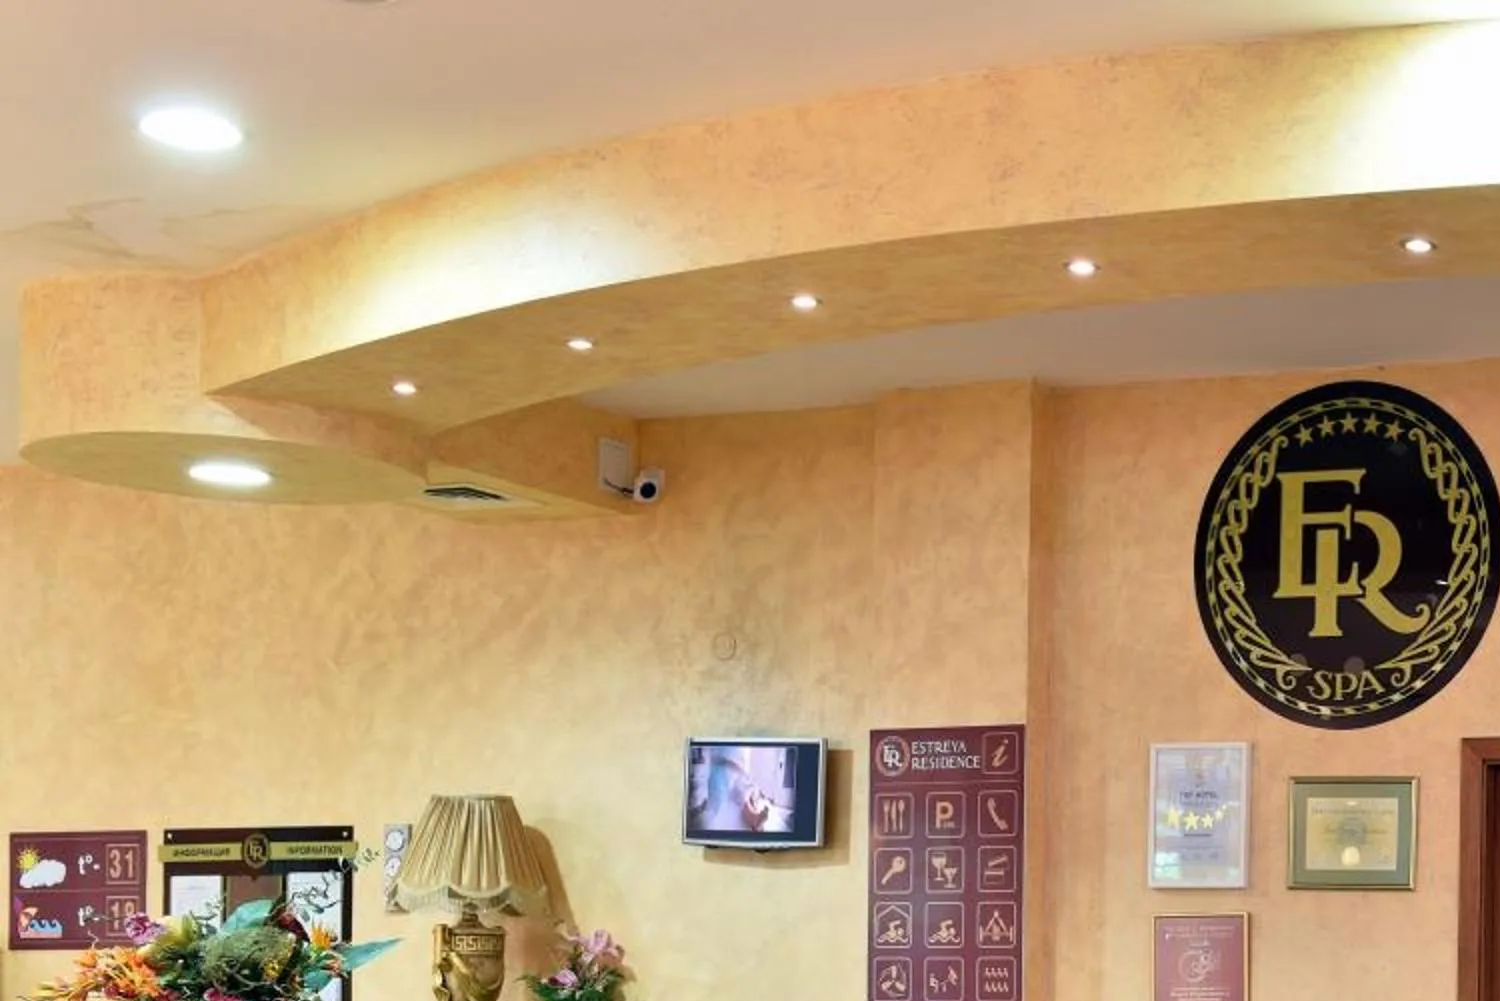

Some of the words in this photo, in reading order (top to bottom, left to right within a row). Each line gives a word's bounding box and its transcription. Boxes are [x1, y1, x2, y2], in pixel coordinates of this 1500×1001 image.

[1306, 669, 1386, 701] SPA
[911, 739, 968, 755] ESTREYA
[911, 755, 981, 770] RESIDENCE
[935, 800, 954, 829] P
[109, 848, 134, 878] 31
